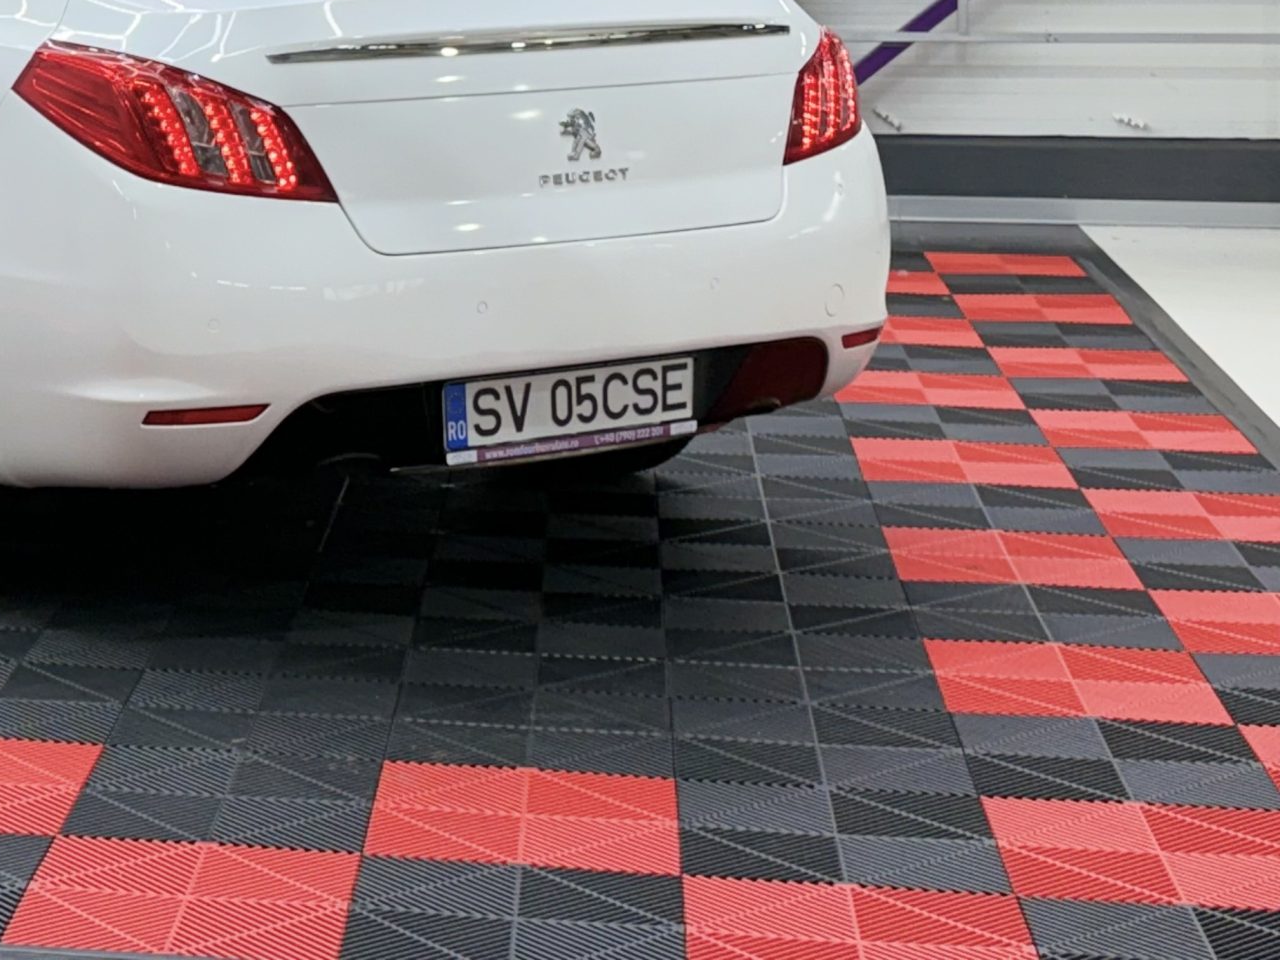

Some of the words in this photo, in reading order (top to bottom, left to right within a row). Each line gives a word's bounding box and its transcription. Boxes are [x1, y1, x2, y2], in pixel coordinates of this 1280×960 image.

[538, 167, 629, 188] PEUGEOT
[472, 382, 532, 437] SV
[551, 362, 688, 427] 05CSE
[447, 420, 467, 441] RO
